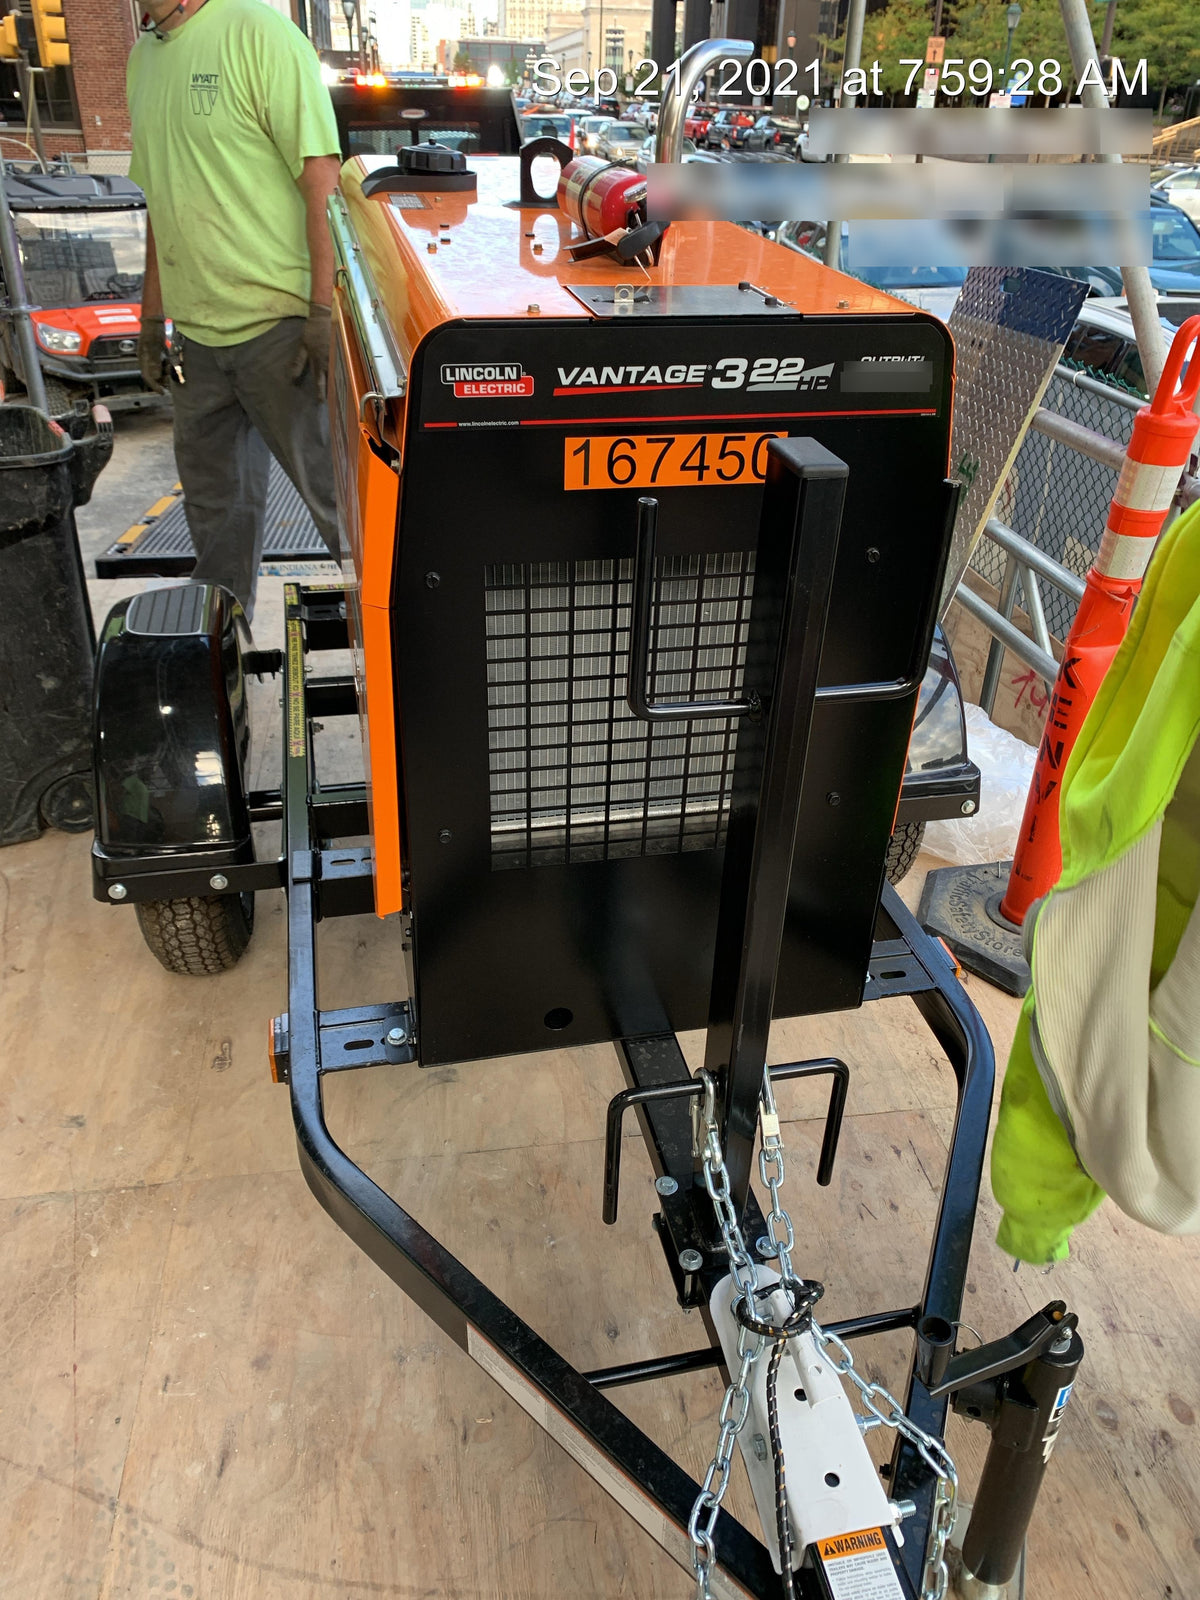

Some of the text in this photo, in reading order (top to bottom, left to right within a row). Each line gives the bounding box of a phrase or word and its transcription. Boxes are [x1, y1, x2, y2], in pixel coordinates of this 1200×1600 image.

[192, 73, 219, 84] WYATT
[445, 366, 517, 381] LINCOLN
[557, 365, 707, 386] VANTAGE
[711, 357, 805, 389] 322
[463, 383, 526, 395] ELECTRIC
[833, 1531, 882, 1553] WARNING
